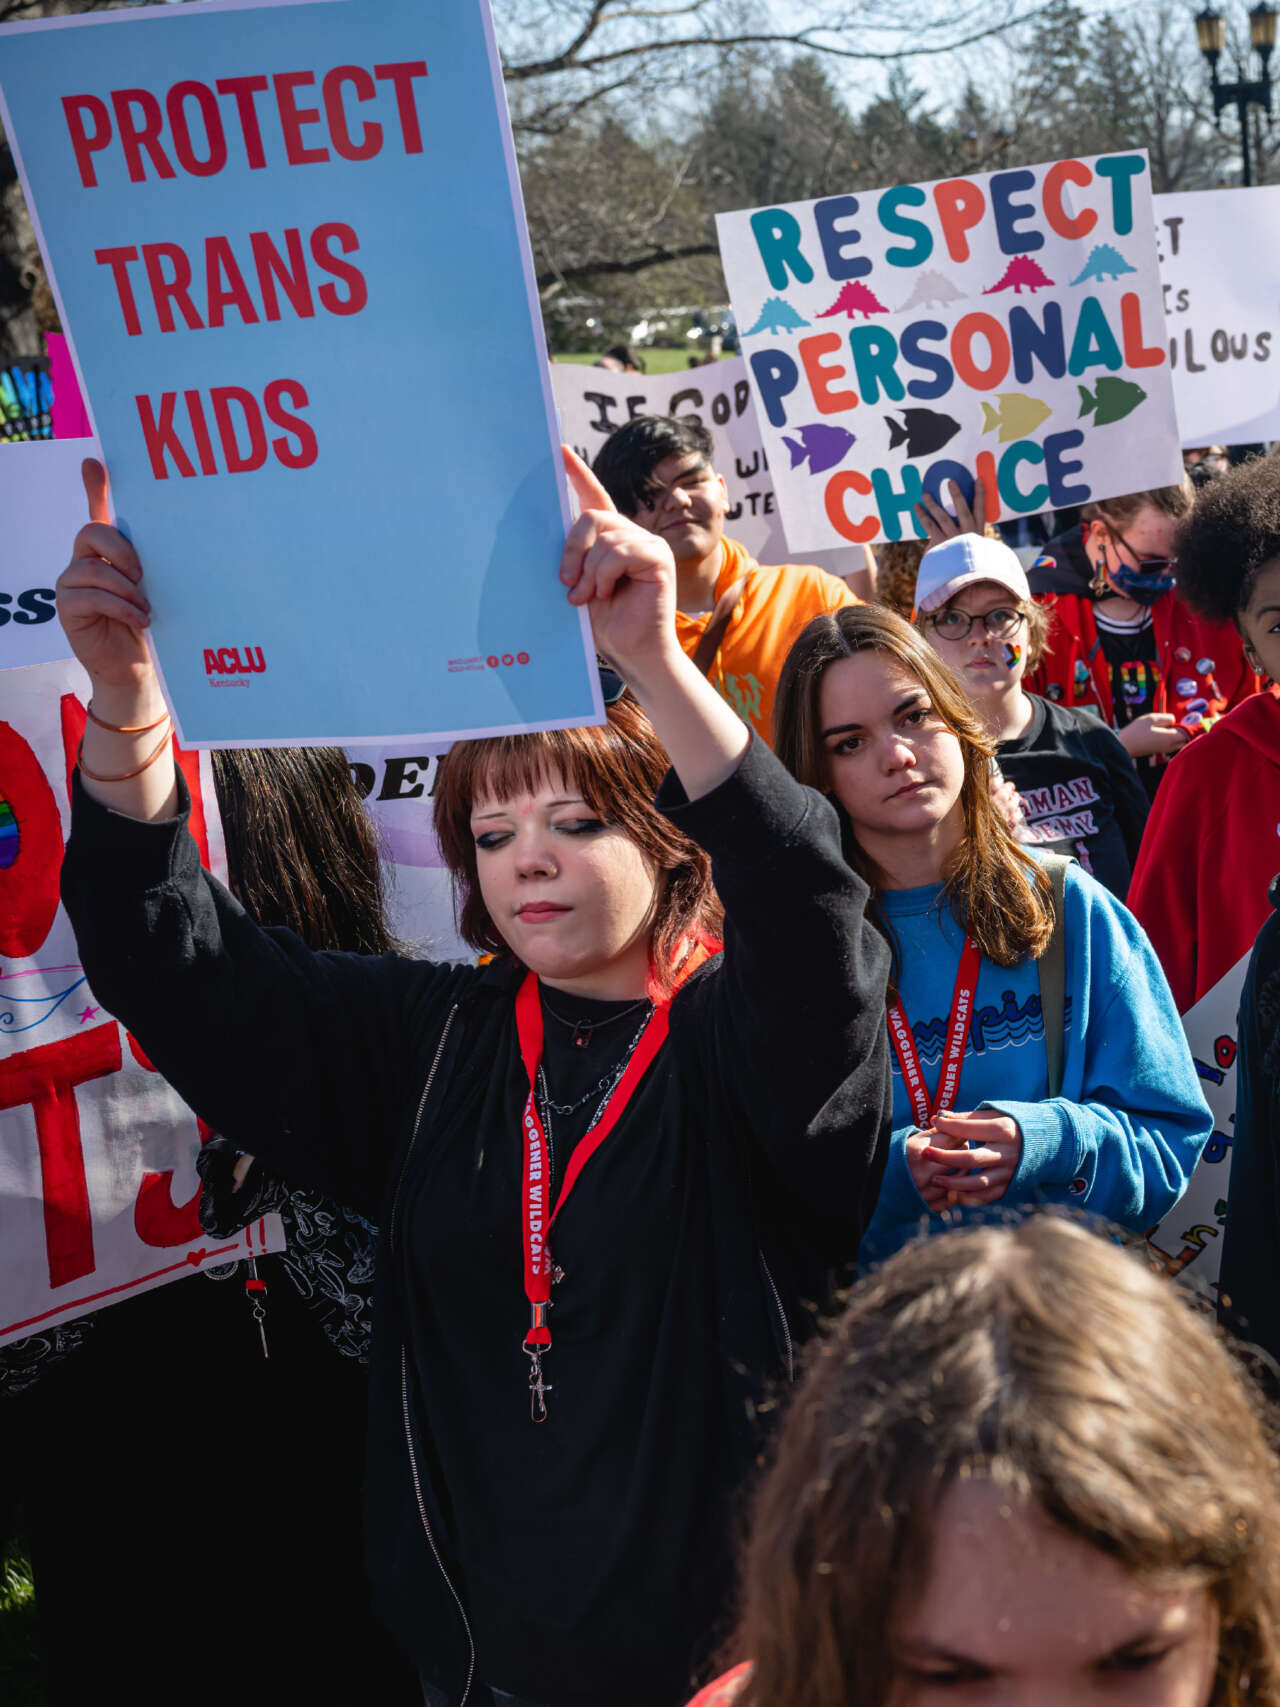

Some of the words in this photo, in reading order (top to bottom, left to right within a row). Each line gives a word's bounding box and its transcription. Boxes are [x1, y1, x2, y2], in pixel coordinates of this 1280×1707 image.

[61, 61, 429, 189] PROTECT
[94, 222, 370, 337] TRANS
[750, 155, 1146, 291] RESPECT
[750, 292, 1166, 428] PERSONAL
[135, 378, 320, 480] KIDS
[824, 429, 1092, 543] CHOICE
[203, 646, 267, 675] ACLU
[888, 1007, 920, 1087] WAGGENER
[938, 1063, 958, 1115] GENER
[949, 988, 971, 1060] WILDCATS
